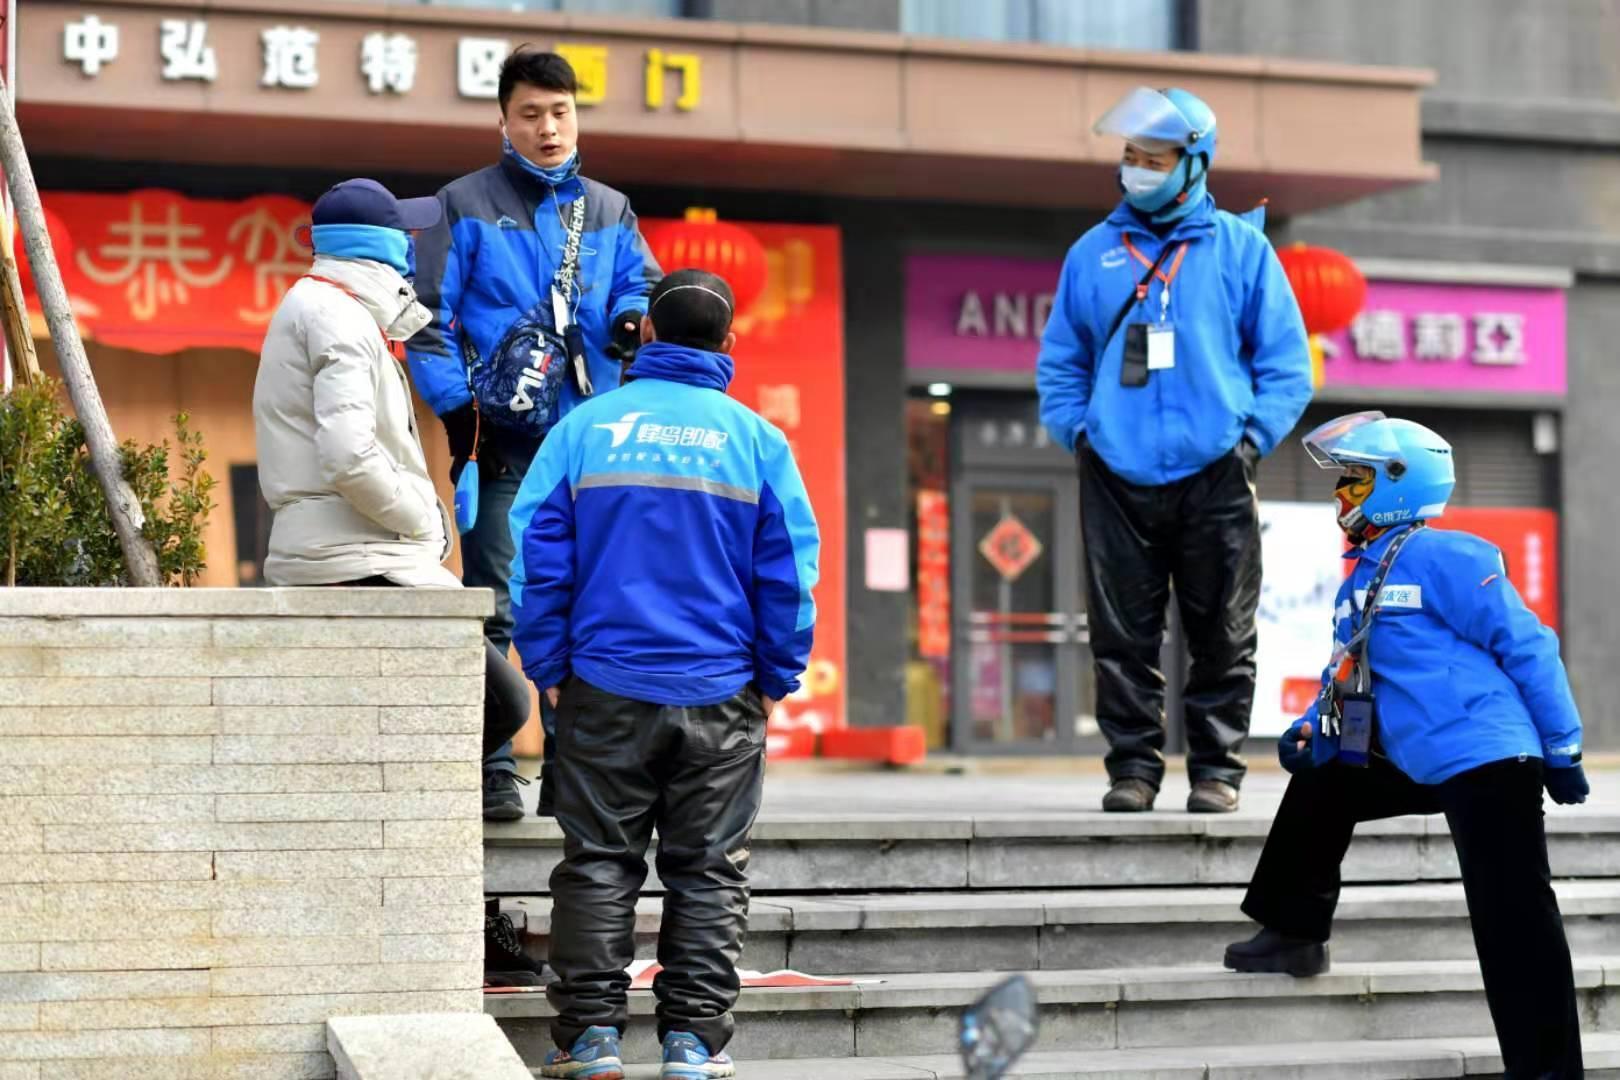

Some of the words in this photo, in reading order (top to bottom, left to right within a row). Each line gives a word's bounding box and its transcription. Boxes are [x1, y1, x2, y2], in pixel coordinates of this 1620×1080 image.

[1322, 310, 1526, 366] 德莉亞
[510, 349, 551, 411] FILA
[636, 423, 728, 450] 蜂鸟即配
